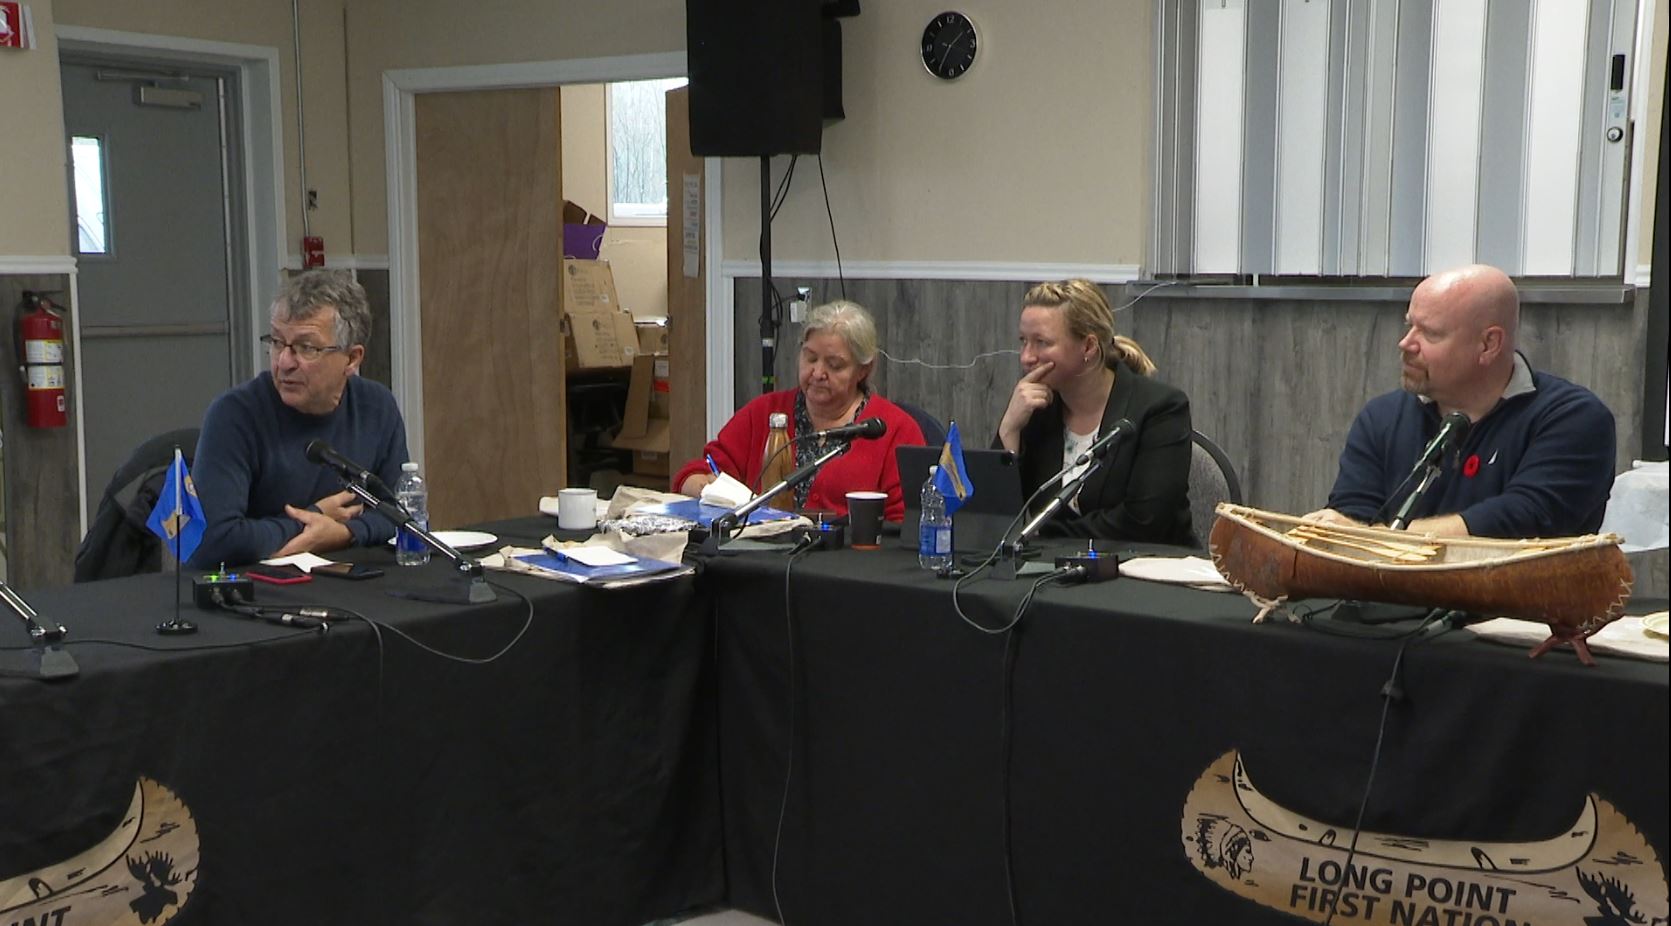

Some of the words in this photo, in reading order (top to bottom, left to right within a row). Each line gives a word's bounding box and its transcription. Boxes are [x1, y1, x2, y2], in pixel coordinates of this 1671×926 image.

[946, 15, 955, 24] 12
[970, 39, 976, 48] 3
[1299, 857, 1393, 894] LONG
[1405, 872, 1517, 914] POINT
[1289, 884, 1380, 920] FIRST
